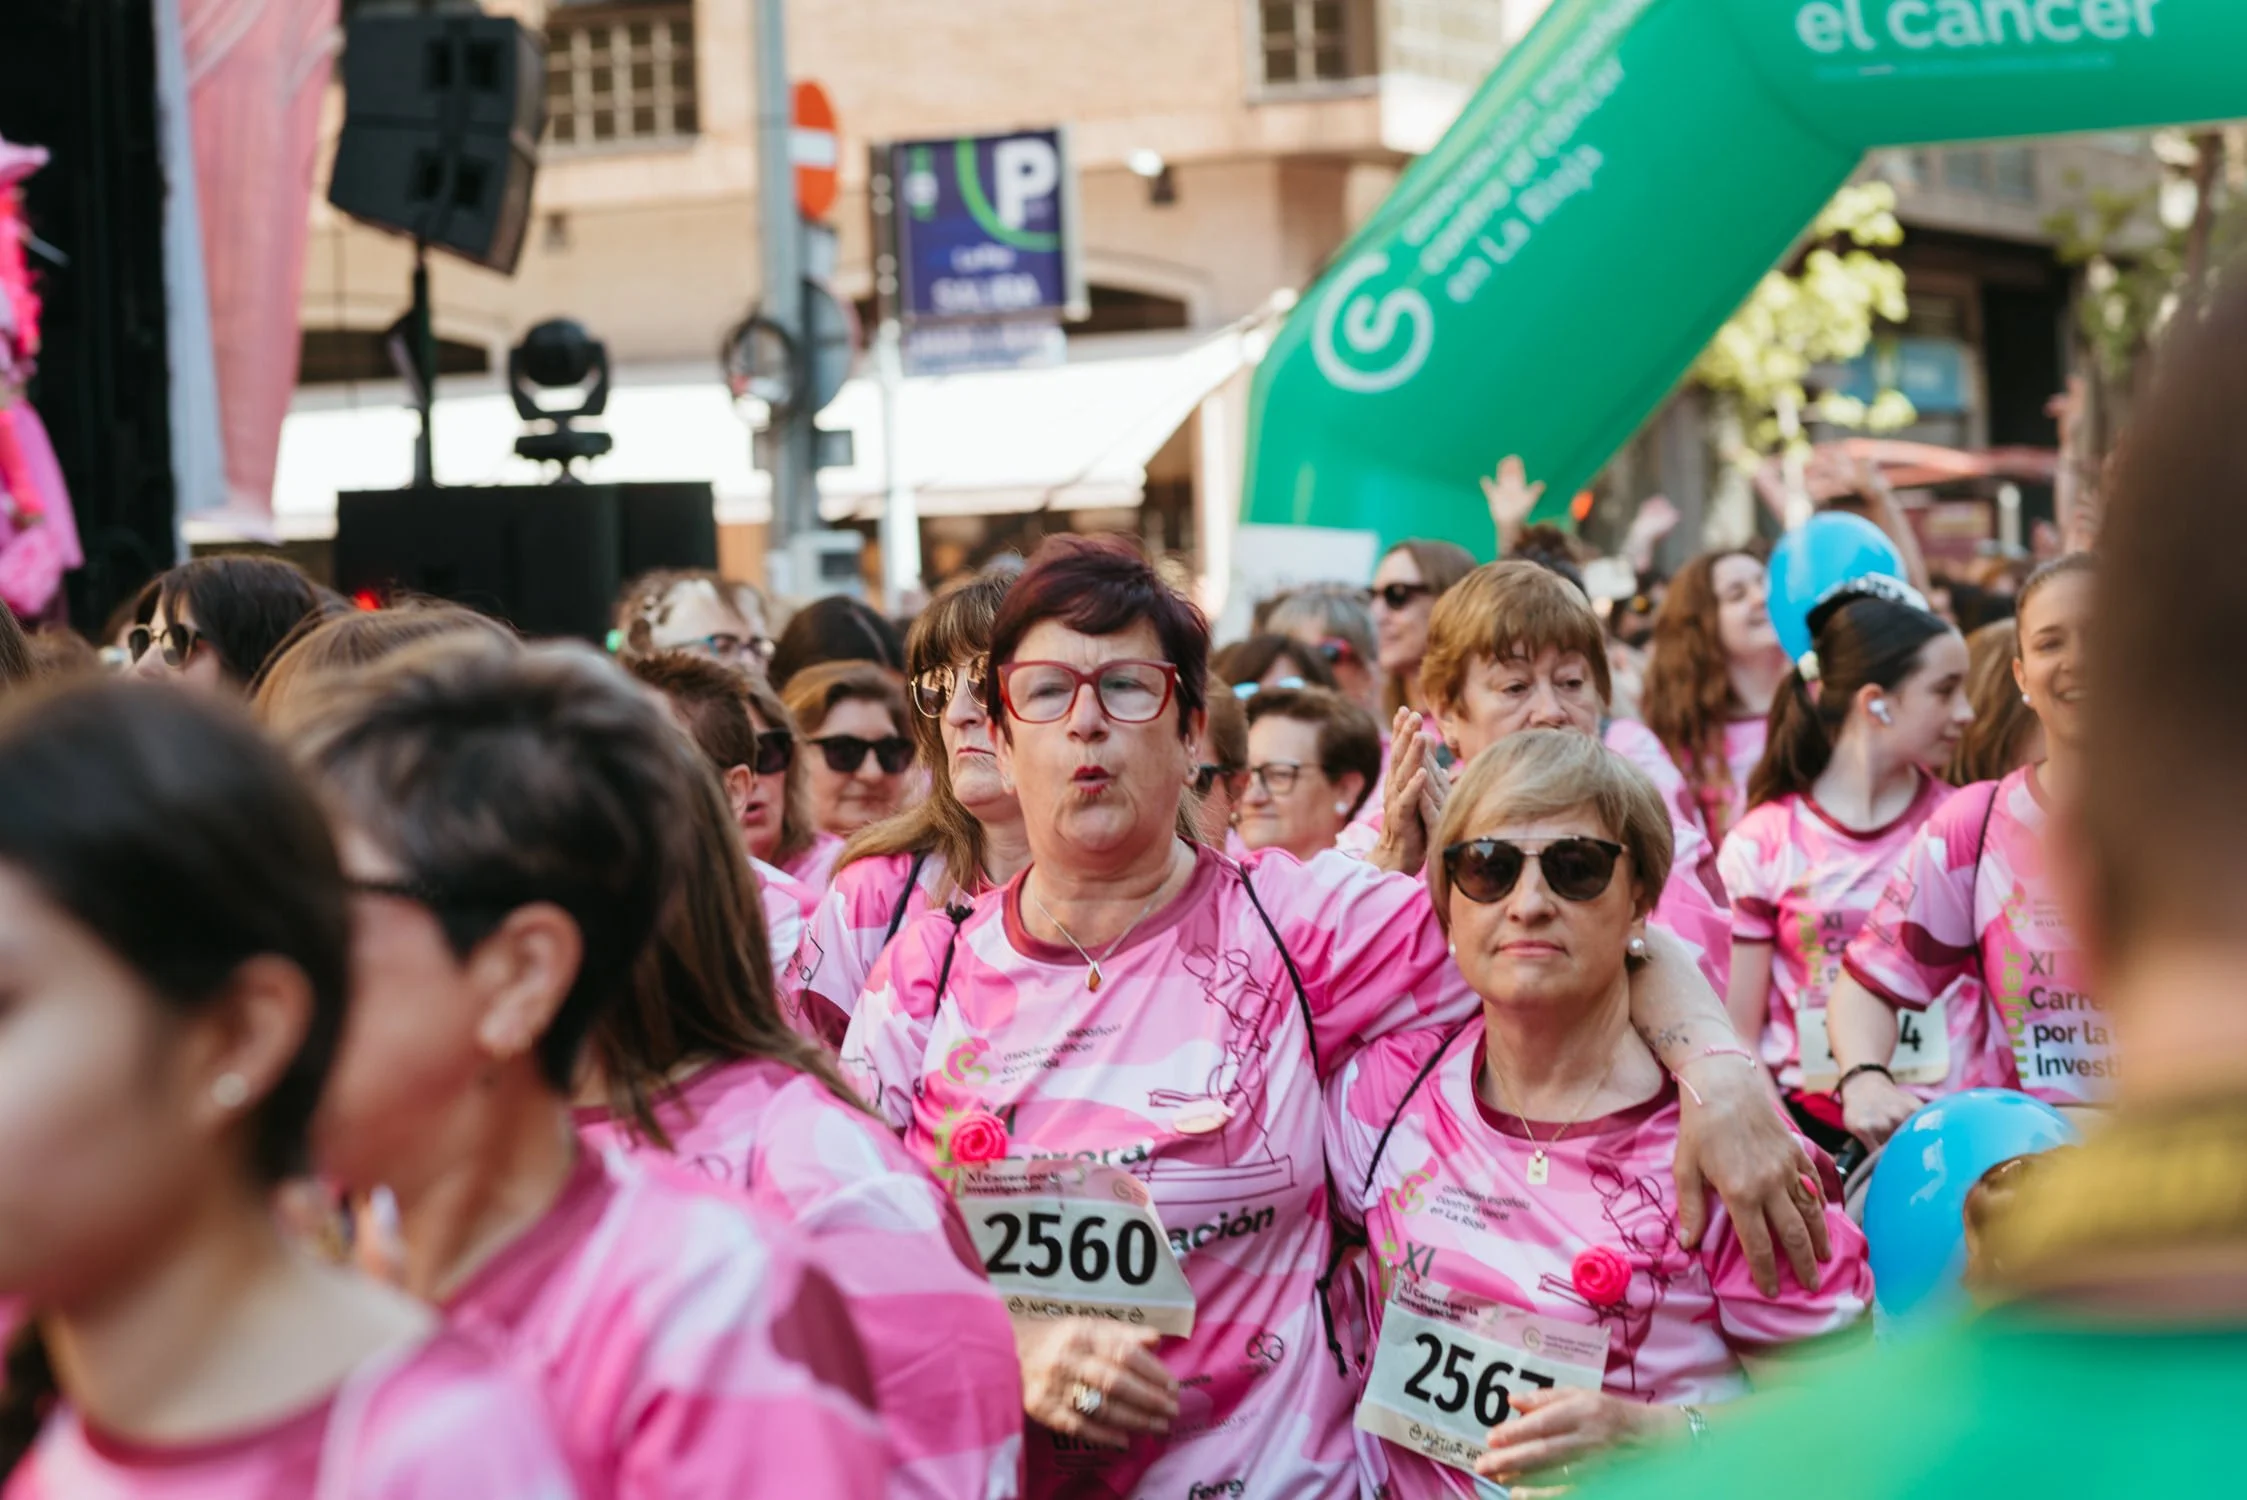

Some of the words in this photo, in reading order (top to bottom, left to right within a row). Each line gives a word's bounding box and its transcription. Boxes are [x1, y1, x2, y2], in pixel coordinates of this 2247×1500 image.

[1796, 0, 1877, 53] el
[992, 137, 1057, 232] P
[1478, 218, 1531, 264] La
[2028, 951, 2055, 976] XI
[2028, 985, 2106, 1012] Carre
[2033, 1022, 2078, 1049] por
[2036, 1052, 2123, 1081] Investi
[1445, 1210, 1459, 1222] La
[1461, 1215, 1487, 1231] Rioja
[983, 1211, 1158, 1287] 2560
[1402, 1240, 1437, 1277] XI
